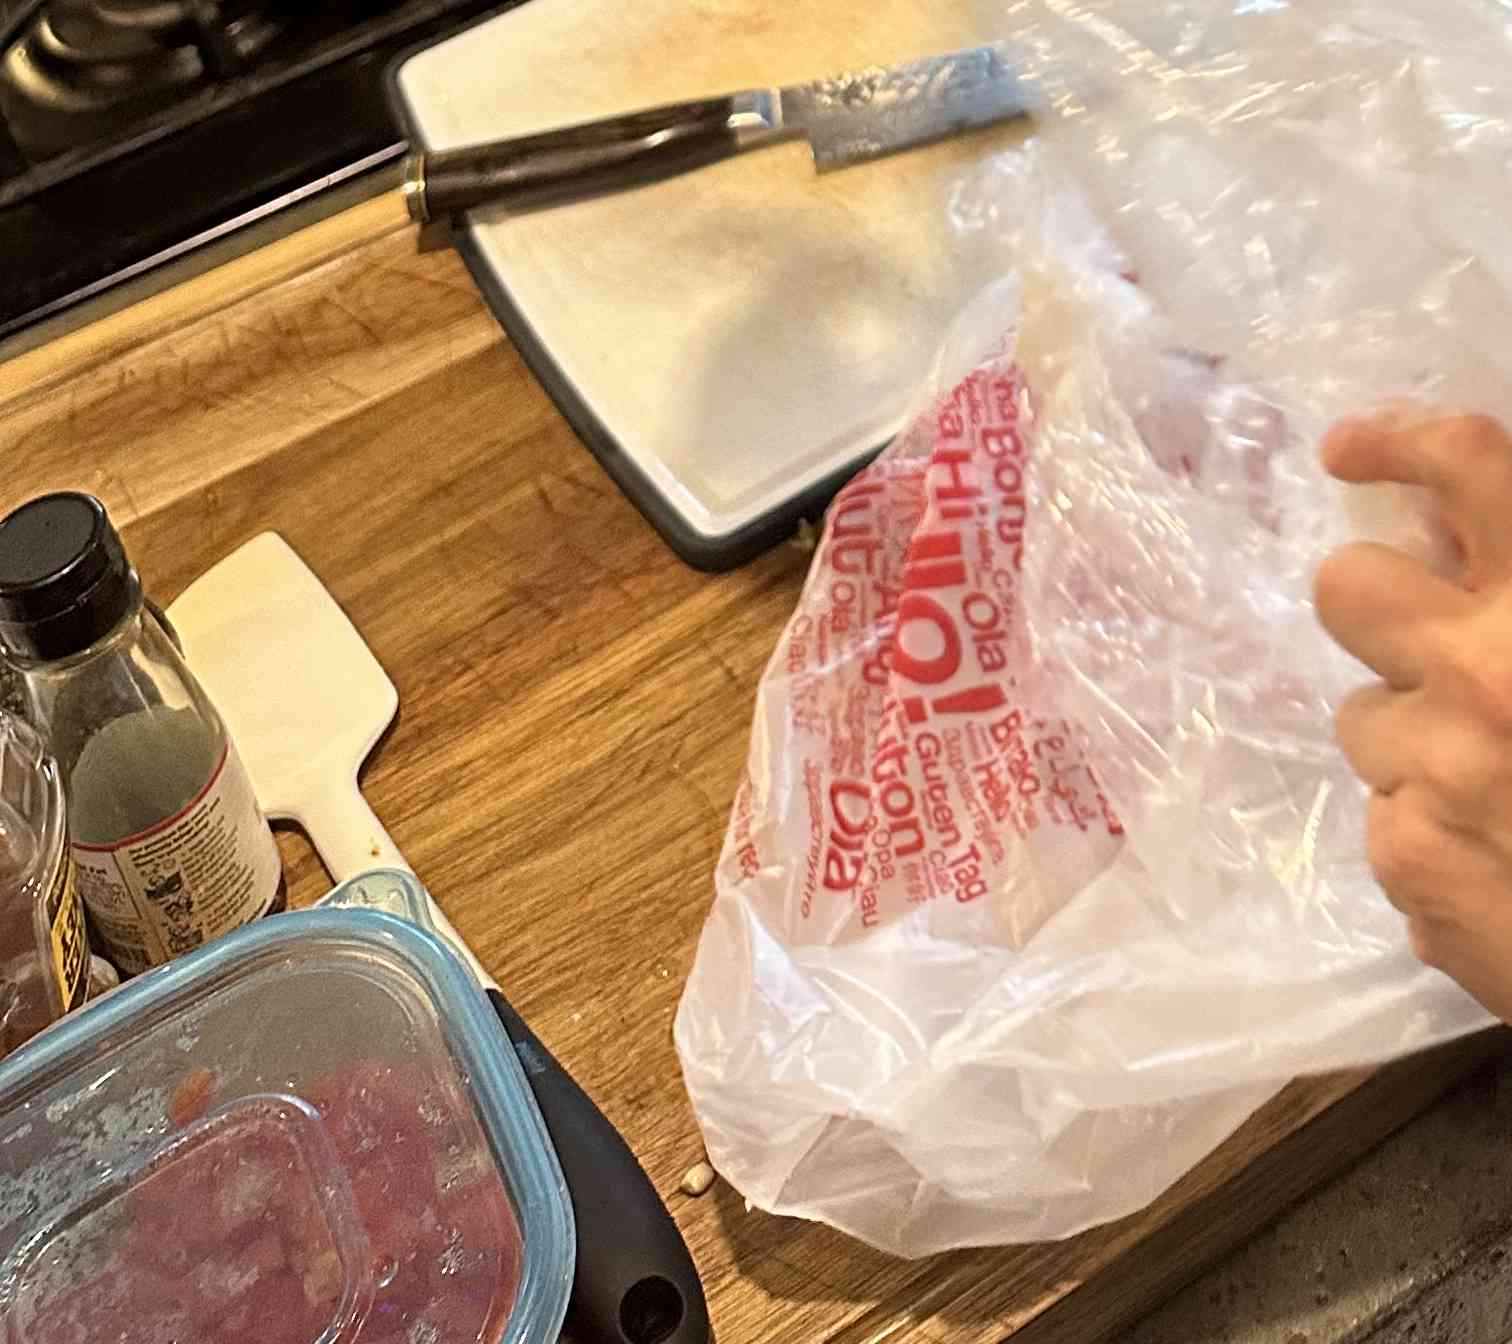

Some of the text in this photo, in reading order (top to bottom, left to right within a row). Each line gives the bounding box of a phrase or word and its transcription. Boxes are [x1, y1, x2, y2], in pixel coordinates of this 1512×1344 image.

[830, 475, 885, 575] lut
[932, 450, 988, 520] Hi
[962, 592, 1007, 672] Ola
[915, 731, 962, 849] Guten
[947, 843, 988, 903] Tag
